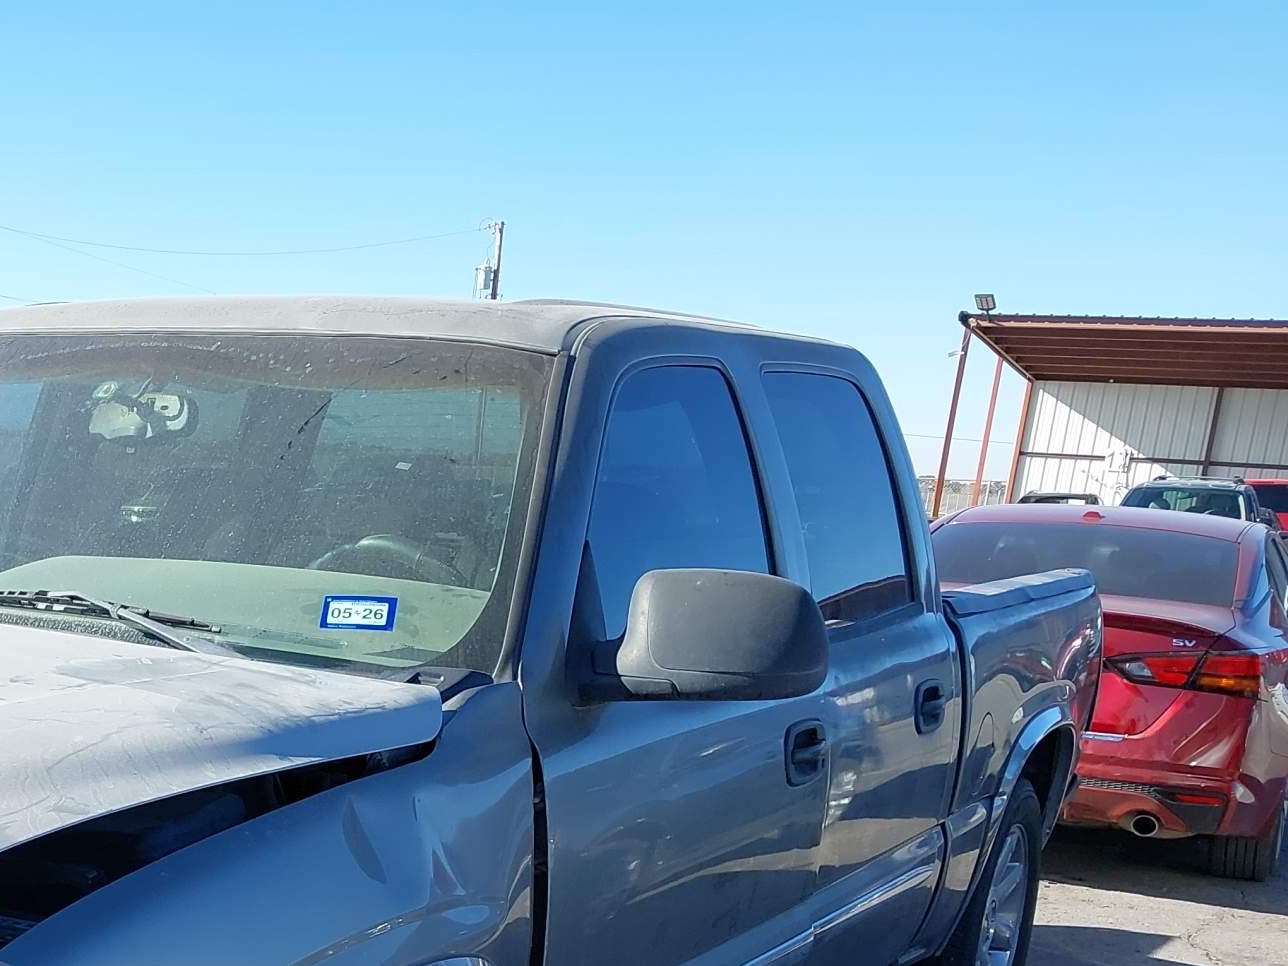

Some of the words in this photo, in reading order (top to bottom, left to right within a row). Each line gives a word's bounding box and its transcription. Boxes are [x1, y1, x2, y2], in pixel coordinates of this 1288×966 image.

[331, 607, 353, 619] 05
[362, 608, 385, 620] 26
[1172, 639, 1196, 647] SV
